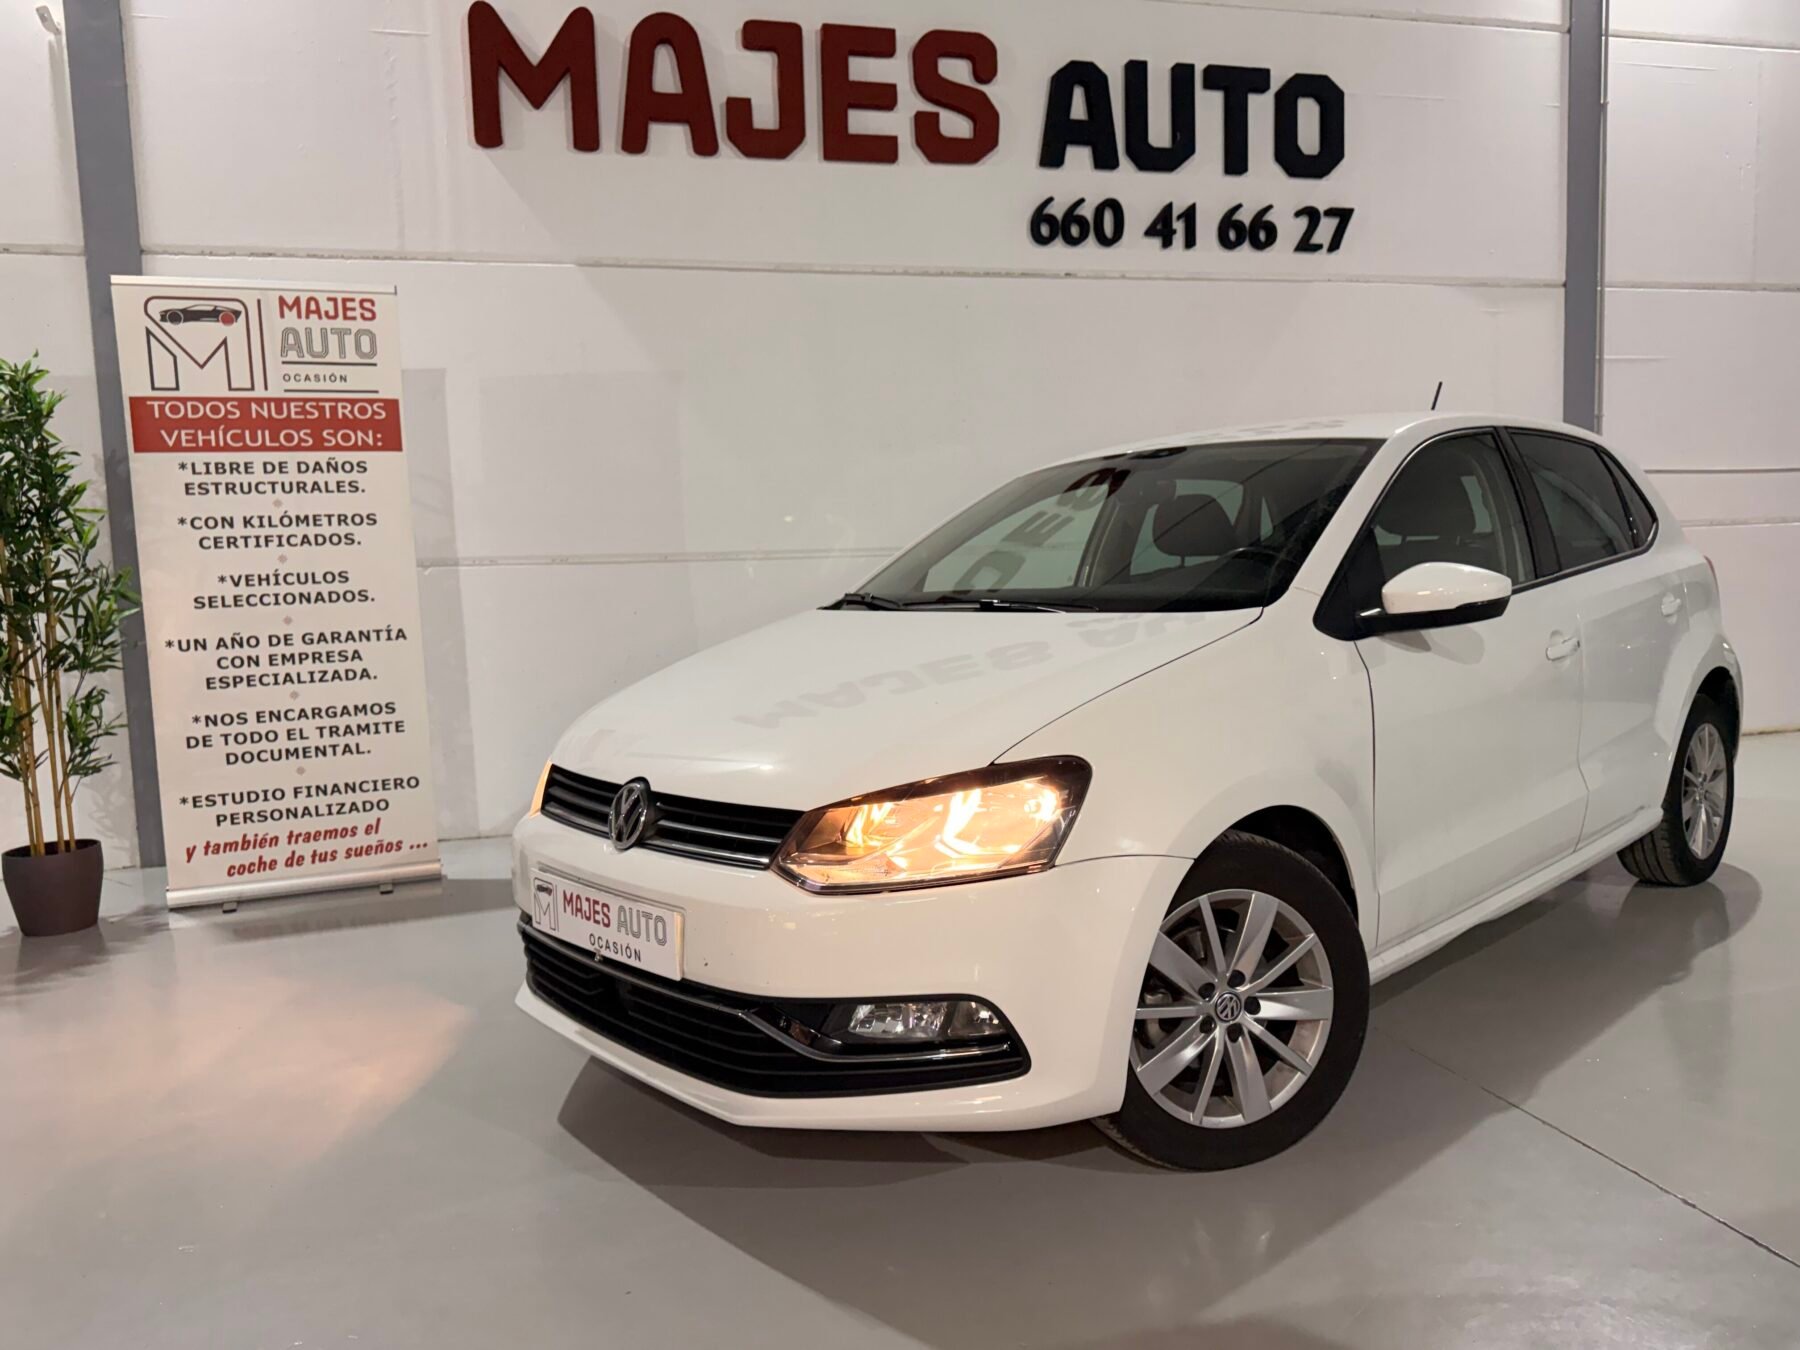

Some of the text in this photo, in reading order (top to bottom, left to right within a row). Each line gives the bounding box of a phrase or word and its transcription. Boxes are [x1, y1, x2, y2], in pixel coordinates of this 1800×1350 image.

[468, 1, 1346, 179] MAJES AUTO
[1030, 197, 1355, 254] 660 41 66 27
[278, 295, 377, 321] MAJES
[280, 327, 378, 359] AUTO
[282, 371, 348, 383] OCASIÓN
[146, 400, 386, 420] TODOS NUESTROS
[160, 425, 382, 448] VEHÍCULOS SON:
[263, 461, 289, 474] DE
[297, 457, 368, 474] DAÑOS
[184, 480, 366, 496] ESTRUCTURALES.
[243, 510, 378, 528] KILÓMETROS
[198, 533, 362, 549] CERTIFICADOS.
[193, 589, 375, 610] SELECCIONADOS.
[216, 632, 260, 650] AÑO
[268, 634, 294, 647] DE
[301, 625, 407, 645] GARANTÍA
[216, 650, 363, 670] CON EMPRESA
[206, 668, 377, 690] ESPECIALIZADA.
[255, 702, 396, 724] ENCARGAMOS
[186, 721, 405, 749] DE TODO EL TRAMITE
[225, 743, 371, 765] DOCUMENTAL.
[293, 776, 420, 799] FINANCIERO
[215, 799, 389, 827] PERSONALIZADO
[185, 818, 381, 863] y también traemos el
[226, 856, 278, 877] coche
[284, 851, 305, 868] de
[310, 848, 338, 865] tus
[344, 838, 403, 858] sueños
[563, 890, 667, 946] MAJES AUTO
[589, 933, 641, 962] OCASIÓN
